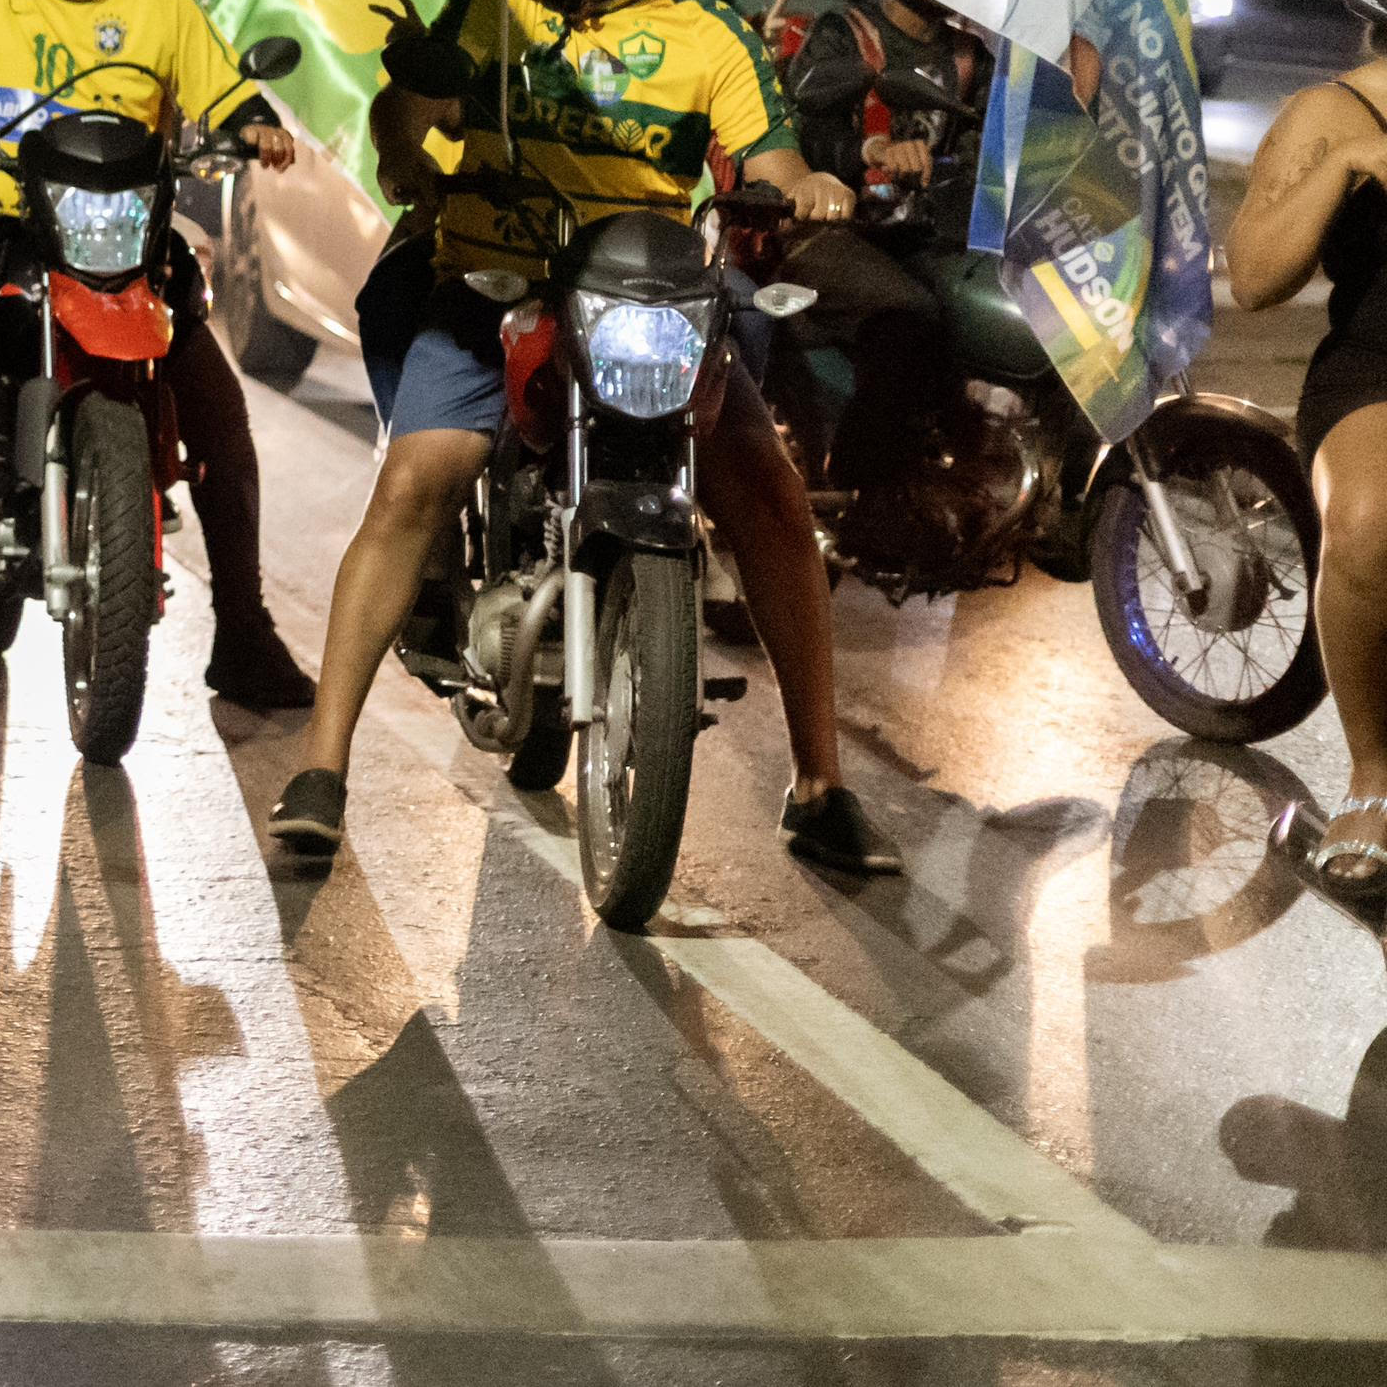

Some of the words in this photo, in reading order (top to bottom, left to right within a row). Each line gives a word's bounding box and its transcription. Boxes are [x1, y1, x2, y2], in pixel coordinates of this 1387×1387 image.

[1119, 1, 1164, 59] NO
[33, 32, 76, 99] 10
[1034, 208, 1135, 355] HUDSON
